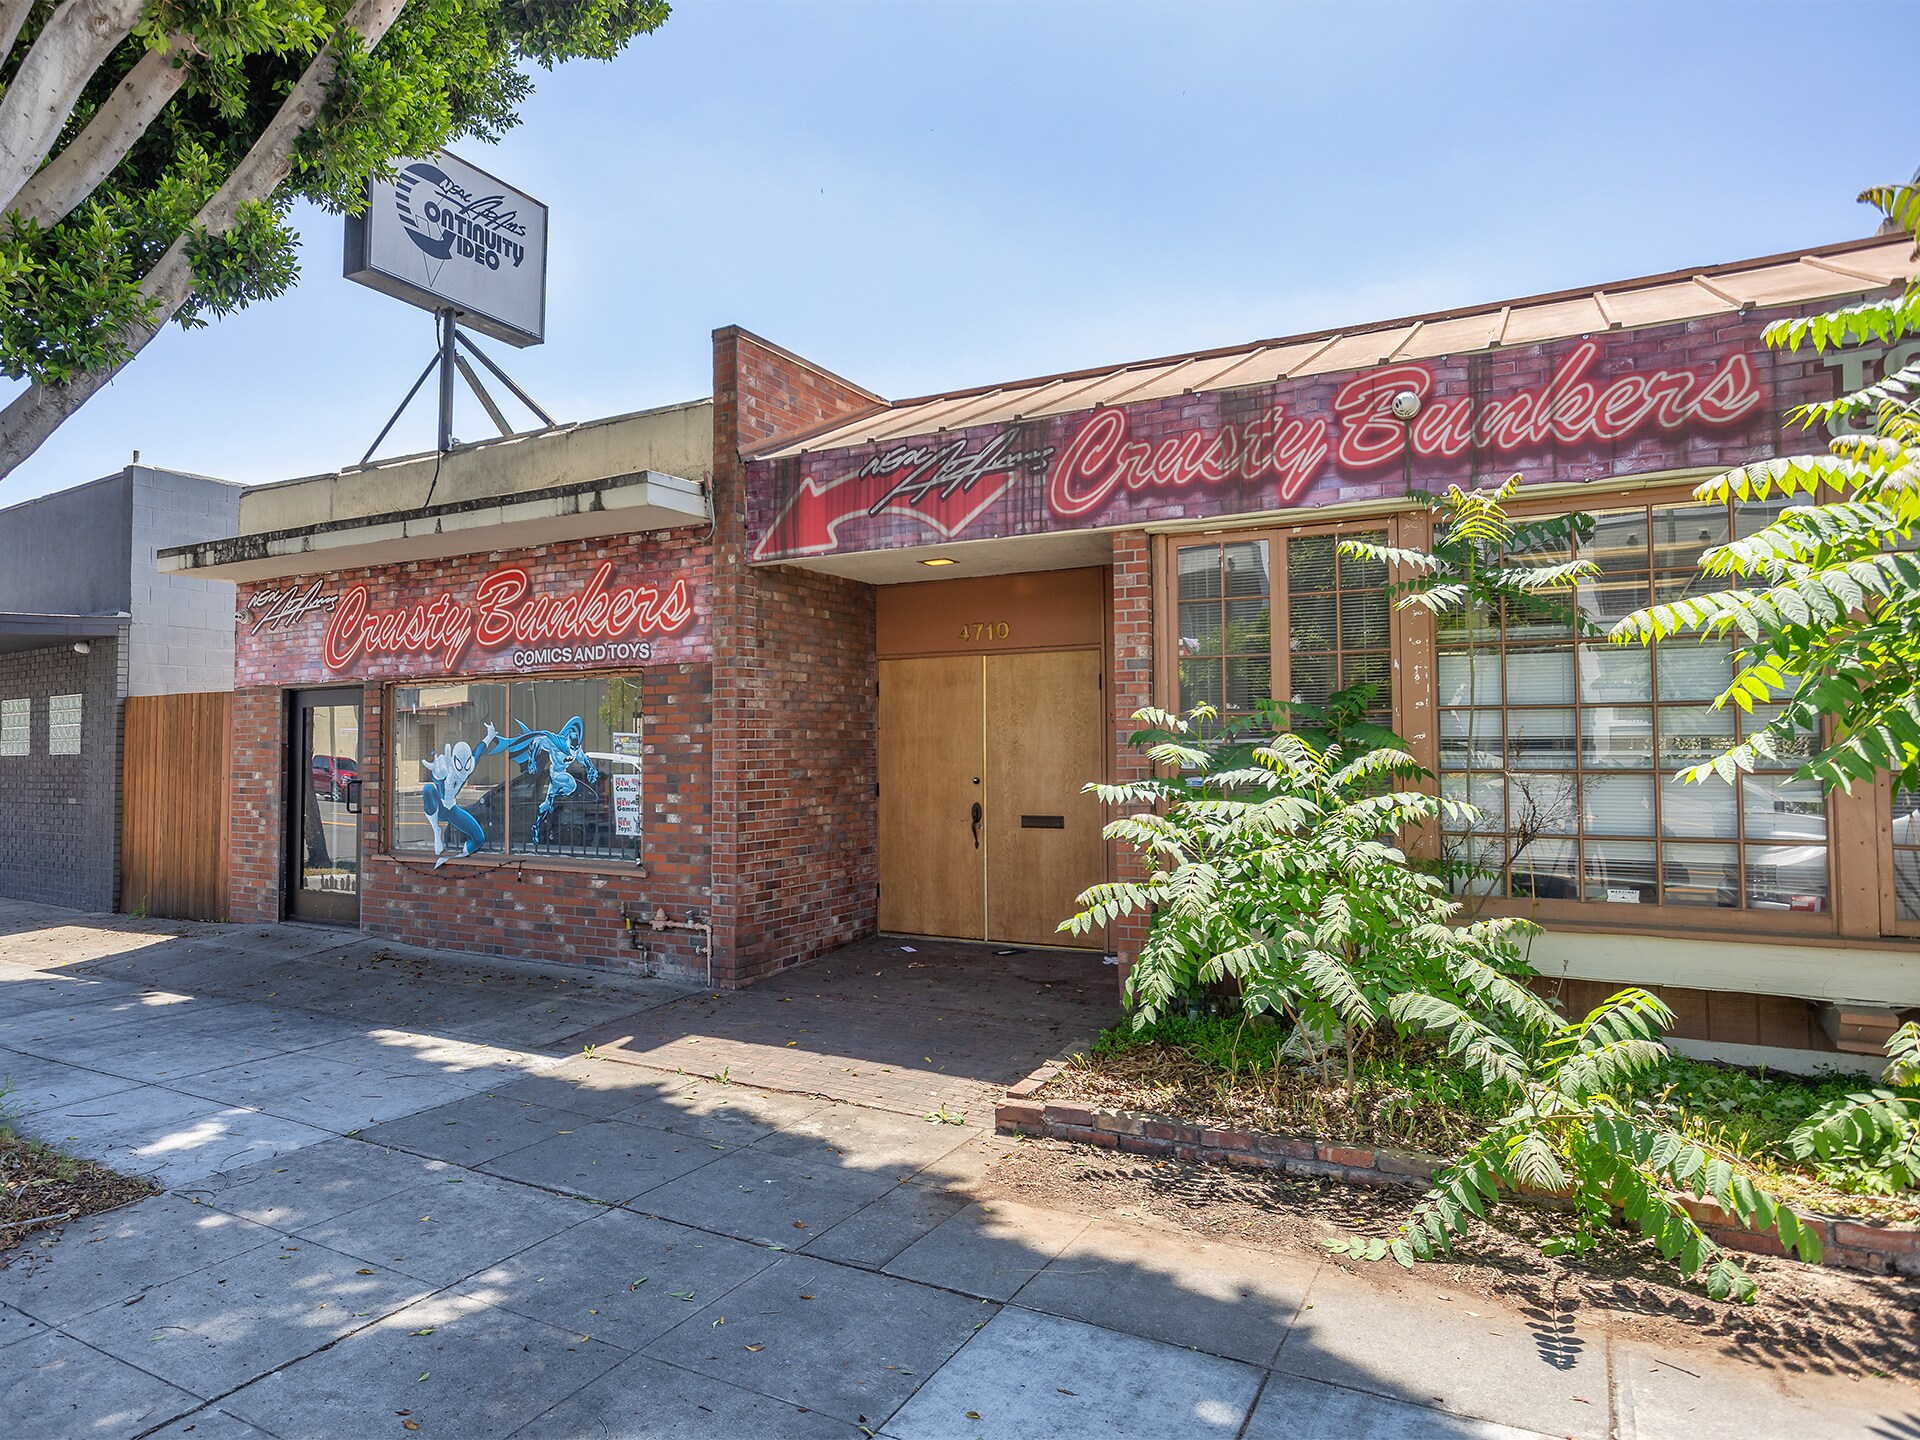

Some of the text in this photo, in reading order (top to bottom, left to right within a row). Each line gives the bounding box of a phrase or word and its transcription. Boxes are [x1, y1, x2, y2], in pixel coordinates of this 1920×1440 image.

[1051, 405, 1328, 516] Crusty
[1336, 343, 1760, 466] Bunkers
[324, 585, 472, 670] Crusty
[476, 561, 692, 646] Bunkers
[959, 621, 1010, 641] 4710
[514, 643, 651, 666] COMICS AND TOYS
